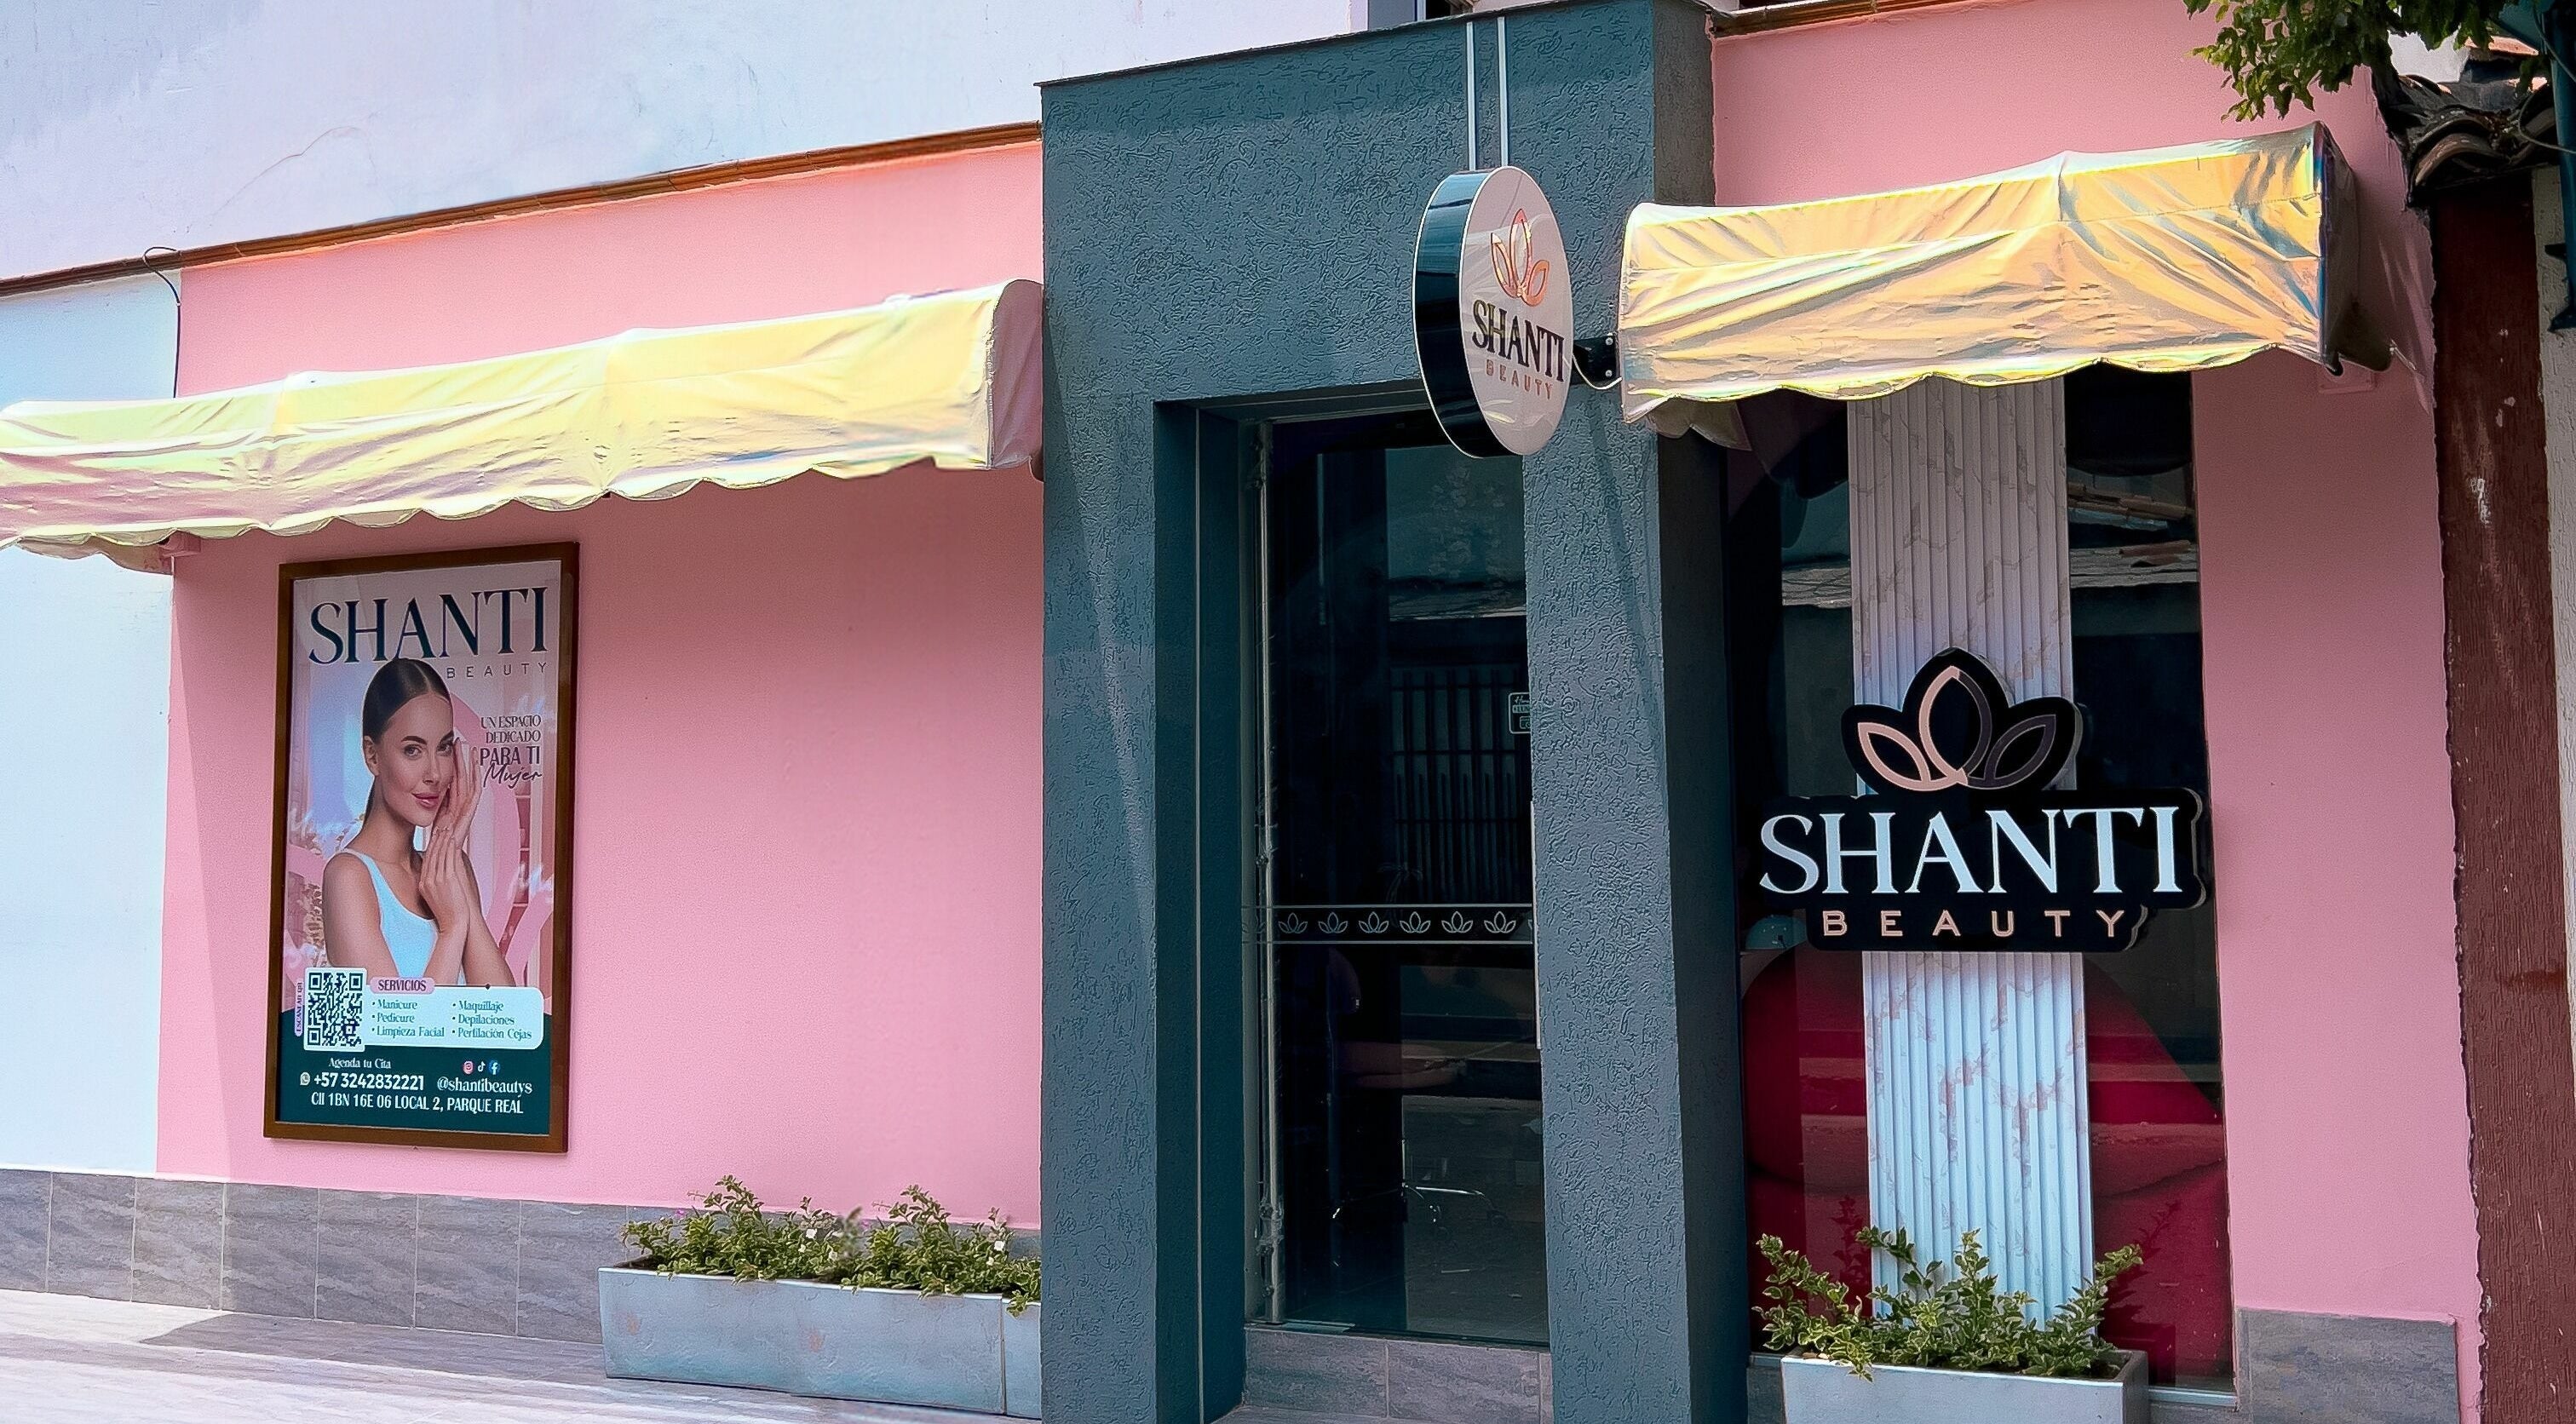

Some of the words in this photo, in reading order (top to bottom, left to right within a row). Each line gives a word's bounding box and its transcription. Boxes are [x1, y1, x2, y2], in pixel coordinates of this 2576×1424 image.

[1472, 299, 1565, 382] SHANTI
[1486, 359, 1553, 399] BEAUTY
[308, 587, 549, 664] SHANTI
[447, 662, 549, 680] BEAUTY
[480, 716, 497, 729] UN
[498, 715, 542, 728] ESPACIO
[486, 729, 542, 744] DEDICADO
[480, 746, 521, 766] PARA
[526, 745, 540, 765] TI
[482, 761, 543, 790] Mujer
[1758, 805, 2184, 895] SHANTI
[1821, 909, 2125, 938] BEAUTY
[377, 979, 427, 991] SERVICIOS
[377, 999, 418, 1010] Manicure
[458, 1000, 504, 1013] Maquillaje
[377, 1012, 416, 1023] Pedicure
[458, 1013, 515, 1027] Depilaciones
[377, 1025, 416, 1038] Limpieza
[418, 1025, 445, 1037] Facial
[507, 1028, 532, 1042] Cejas
[328, 1057, 361, 1069] Agenda
[363, 1059, 372, 1069] tu
[374, 1058, 392, 1069] Cita
[313, 1071, 339, 1088] +57
[436, 1076, 533, 1098] @shantibeautys
[353, 1094, 374, 1108] 16E
[377, 1094, 392, 1109] 06
[394, 1095, 429, 1111] LOCAL
[432, 1096, 444, 1113] 2,
[446, 1097, 492, 1115] PARQUE
[495, 1099, 524, 1114] REAL
